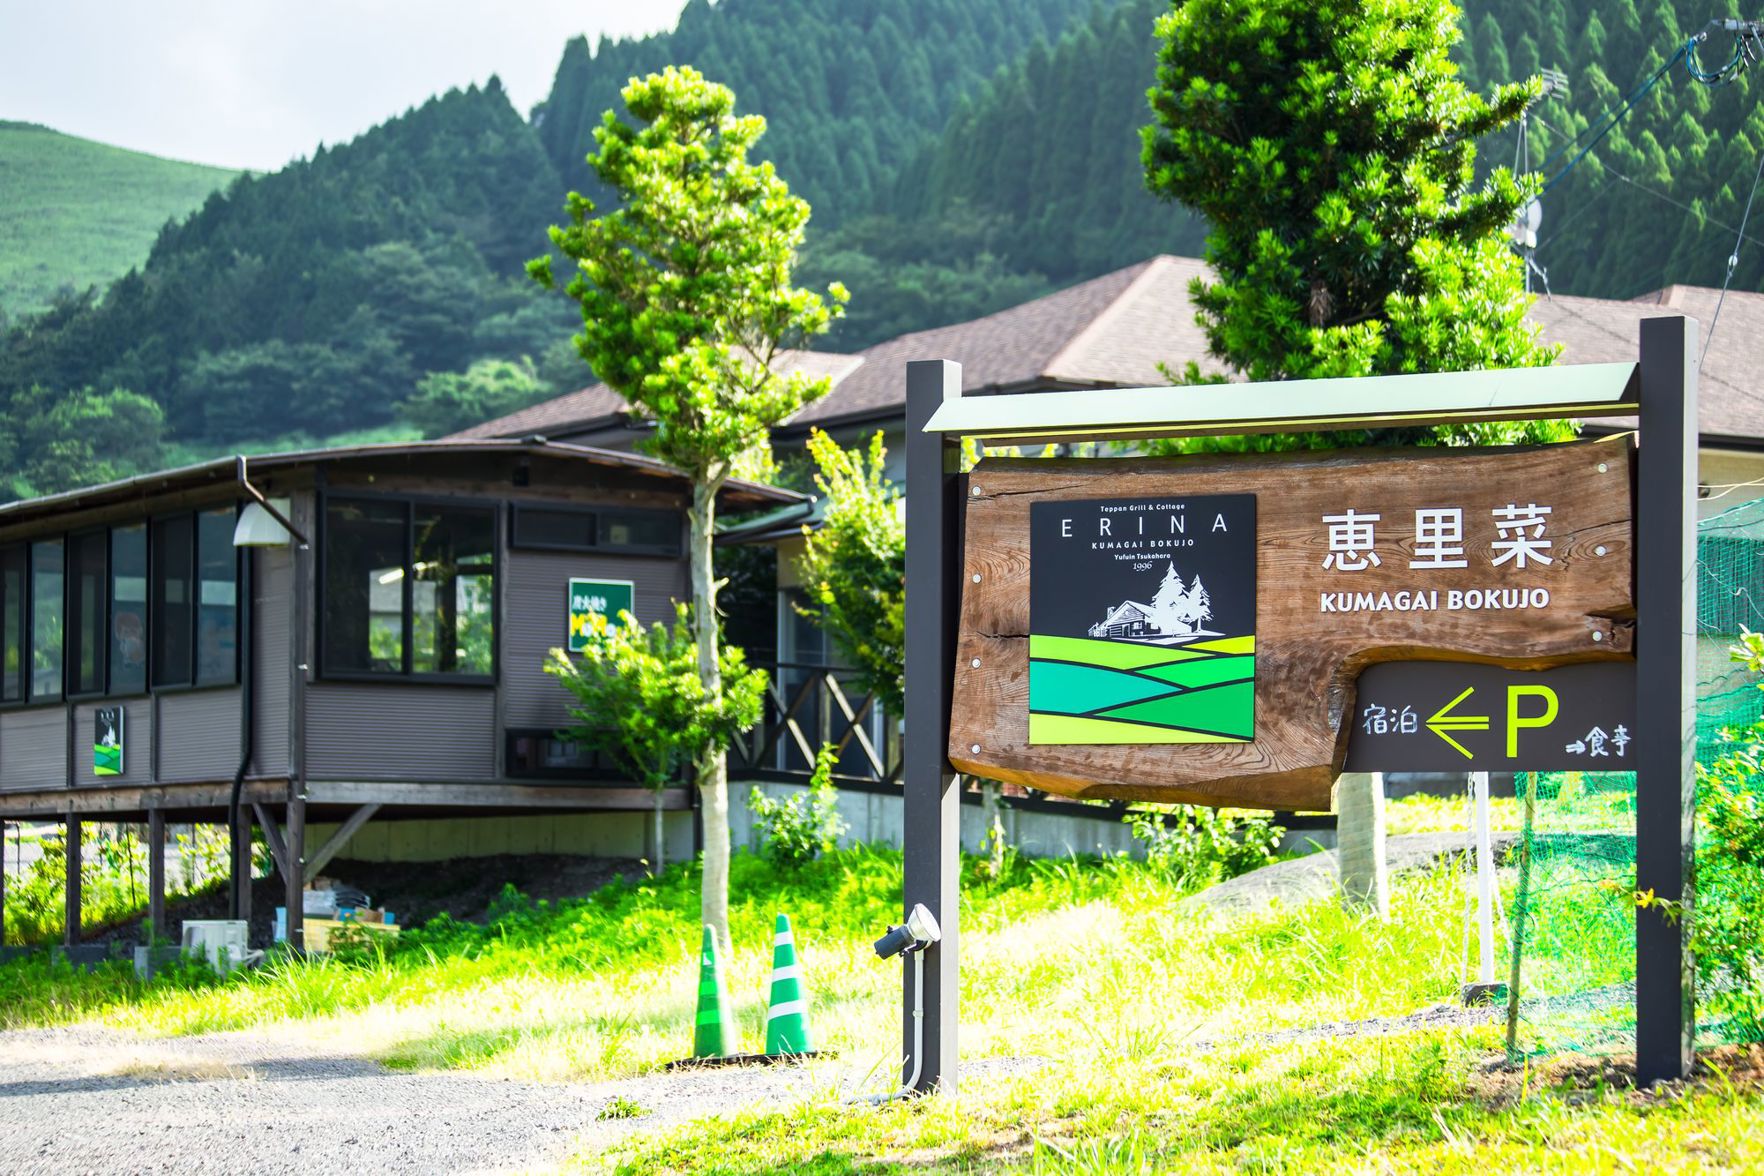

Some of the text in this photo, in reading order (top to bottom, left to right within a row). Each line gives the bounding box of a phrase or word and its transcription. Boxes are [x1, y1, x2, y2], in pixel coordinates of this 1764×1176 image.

[1100, 505, 1128, 513] Teppan
[1156, 503, 1186, 511] Cottage
[1061, 513, 1228, 538] ERINA
[1321, 503, 1553, 571] 恵里菜
[1091, 538, 1195, 550] KUMAGAI BOKUJO
[1132, 560, 1153, 572] 1996
[1320, 588, 1550, 613] KUMAGAI BOKUJO
[1362, 703, 1418, 735] 宿泊
[1506, 684, 1559, 758] P
[1584, 723, 1632, 758] 食事
